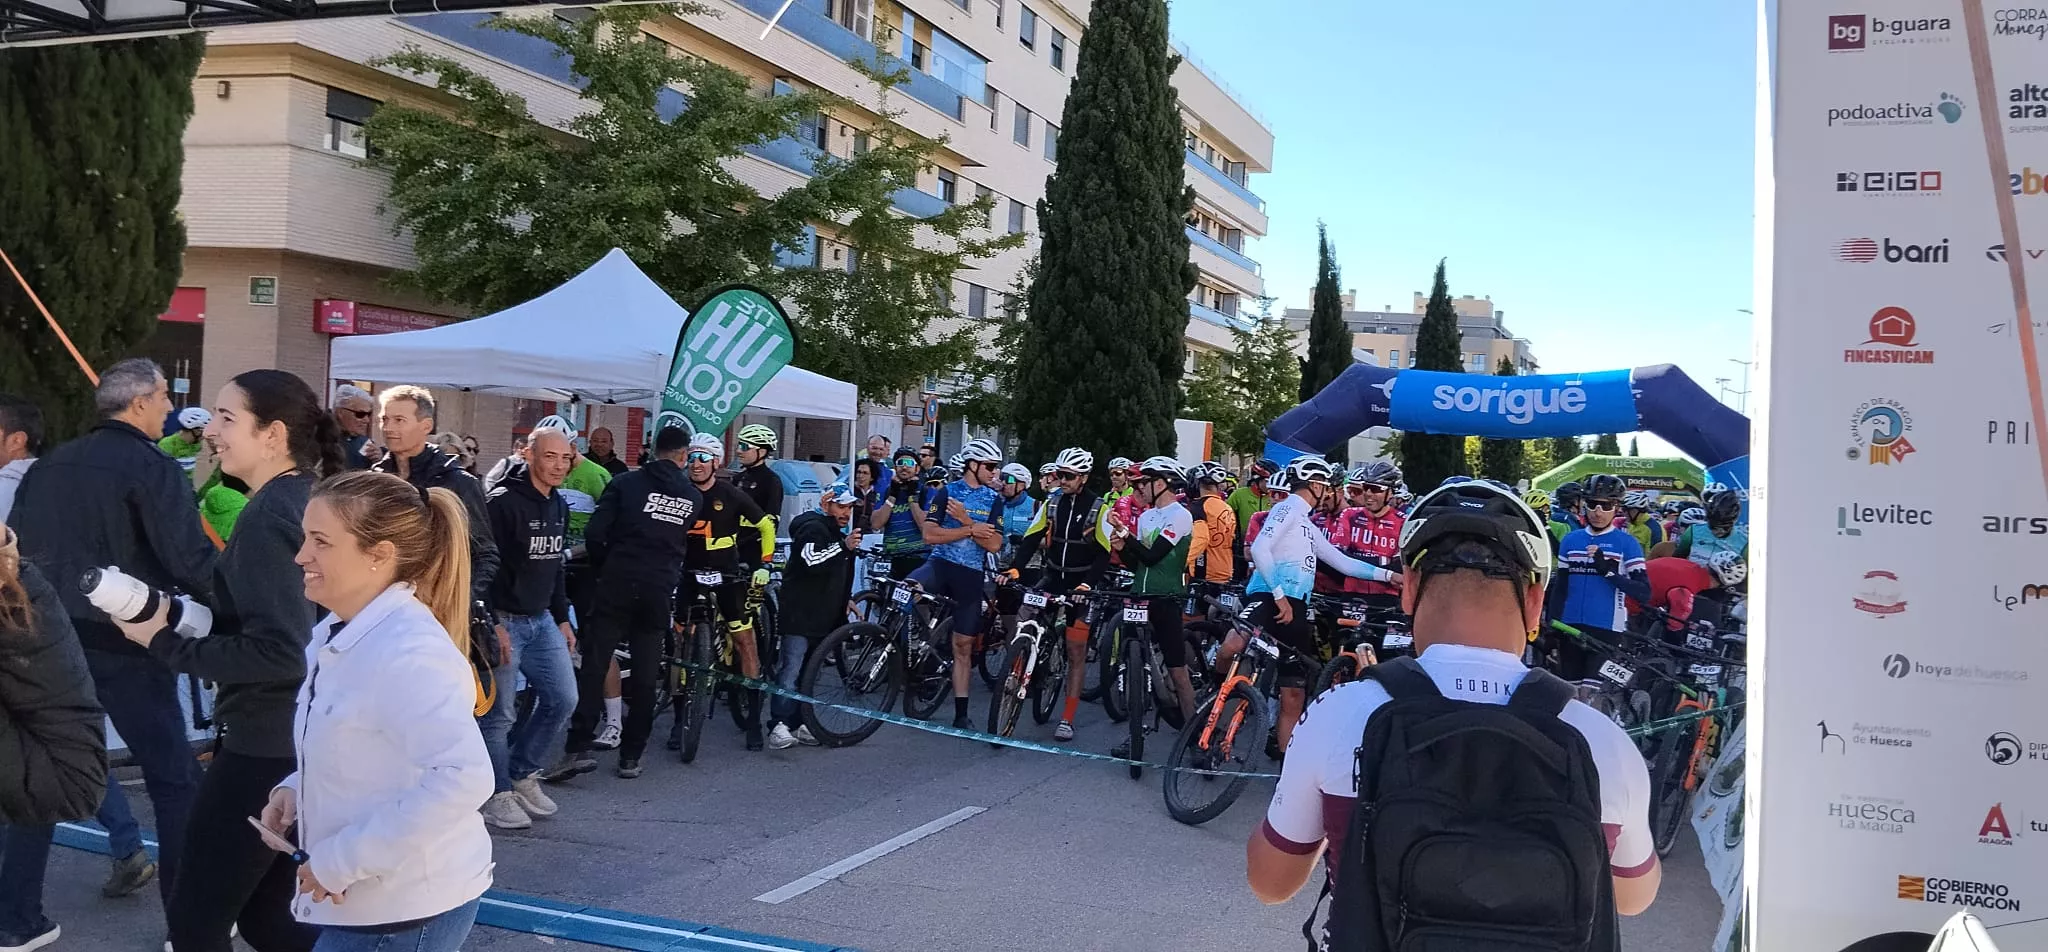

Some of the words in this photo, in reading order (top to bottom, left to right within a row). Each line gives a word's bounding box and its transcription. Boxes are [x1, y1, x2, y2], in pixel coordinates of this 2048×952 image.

[1833, 23, 1861, 42] bg
[1828, 103, 1933, 126] podoactiva
[1884, 238, 1949, 263] barri
[688, 300, 784, 380] HU
[1844, 350, 1935, 365] FINCASVICAM
[685, 400, 722, 425] FONDO
[643, 501, 692, 519] DESERT
[647, 492, 694, 513] GRAVEL
[1127, 610, 1143, 619] 271
[1606, 664, 1625, 680] 846
[1915, 661, 1952, 678] hoya
[1975, 667, 2028, 681] huesca
[1455, 678, 1512, 697] GOBIK
[1853, 734, 1867, 745] de
[1869, 735, 1913, 748] Huesca
[1829, 803, 1916, 824] Huesca
[1926, 877, 2009, 897] GOBIERNO
[1926, 890, 1947, 904] DE
